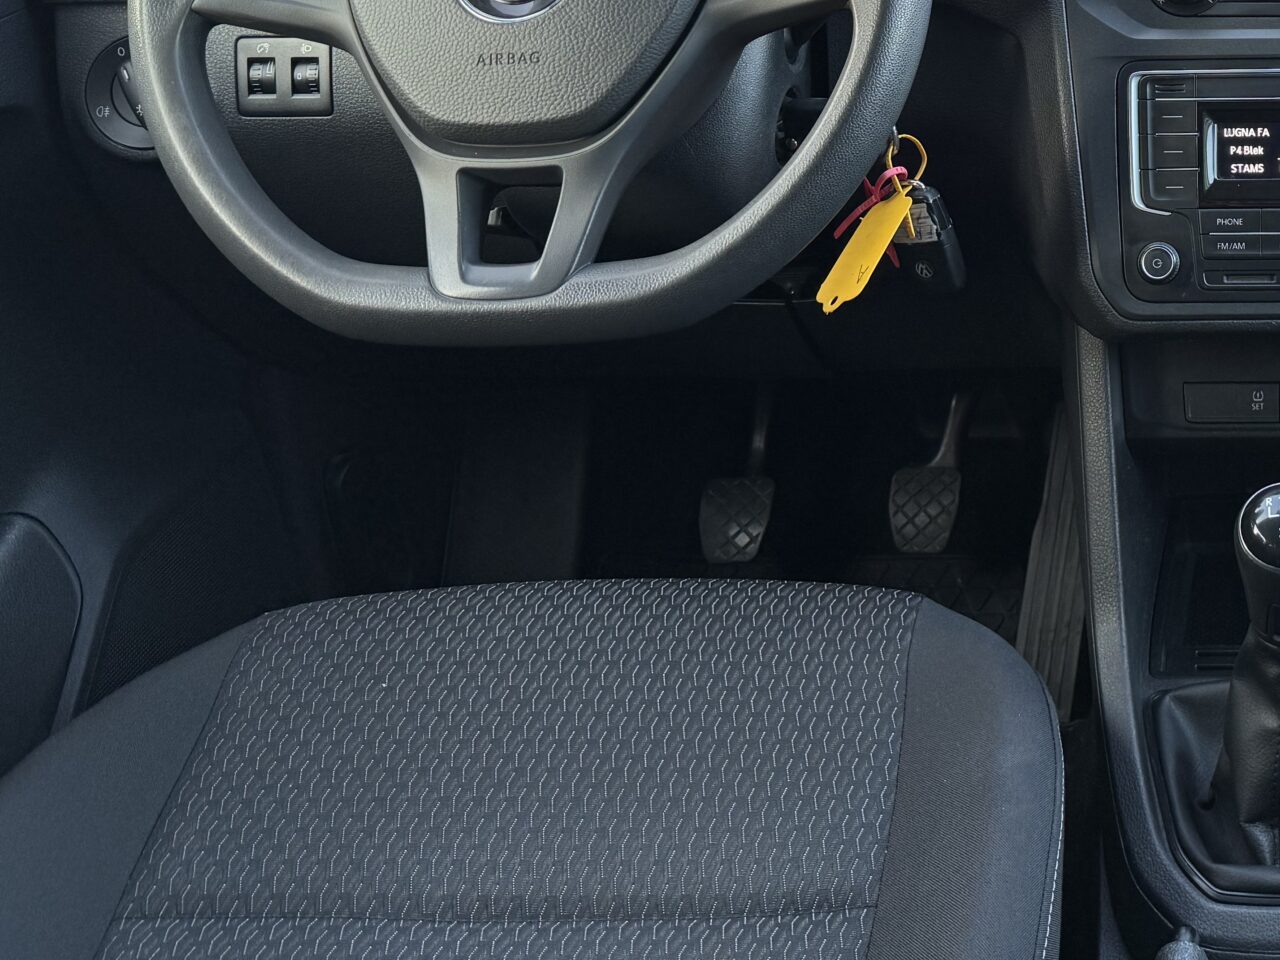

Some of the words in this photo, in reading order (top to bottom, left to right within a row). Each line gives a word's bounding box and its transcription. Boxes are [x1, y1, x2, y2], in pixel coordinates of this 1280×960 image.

[476, 51, 541, 67] AIRBAG
[1223, 128, 1256, 137] LUGNA
[1257, 128, 1270, 137] FA
[1230, 146, 1242, 155] P4
[1230, 164, 1265, 174] STAMS
[1217, 218, 1243, 226] PHONE
[1217, 242, 1246, 250] FM/AM
[1251, 402, 1264, 411] SET
[1265, 497, 1273, 507] R
